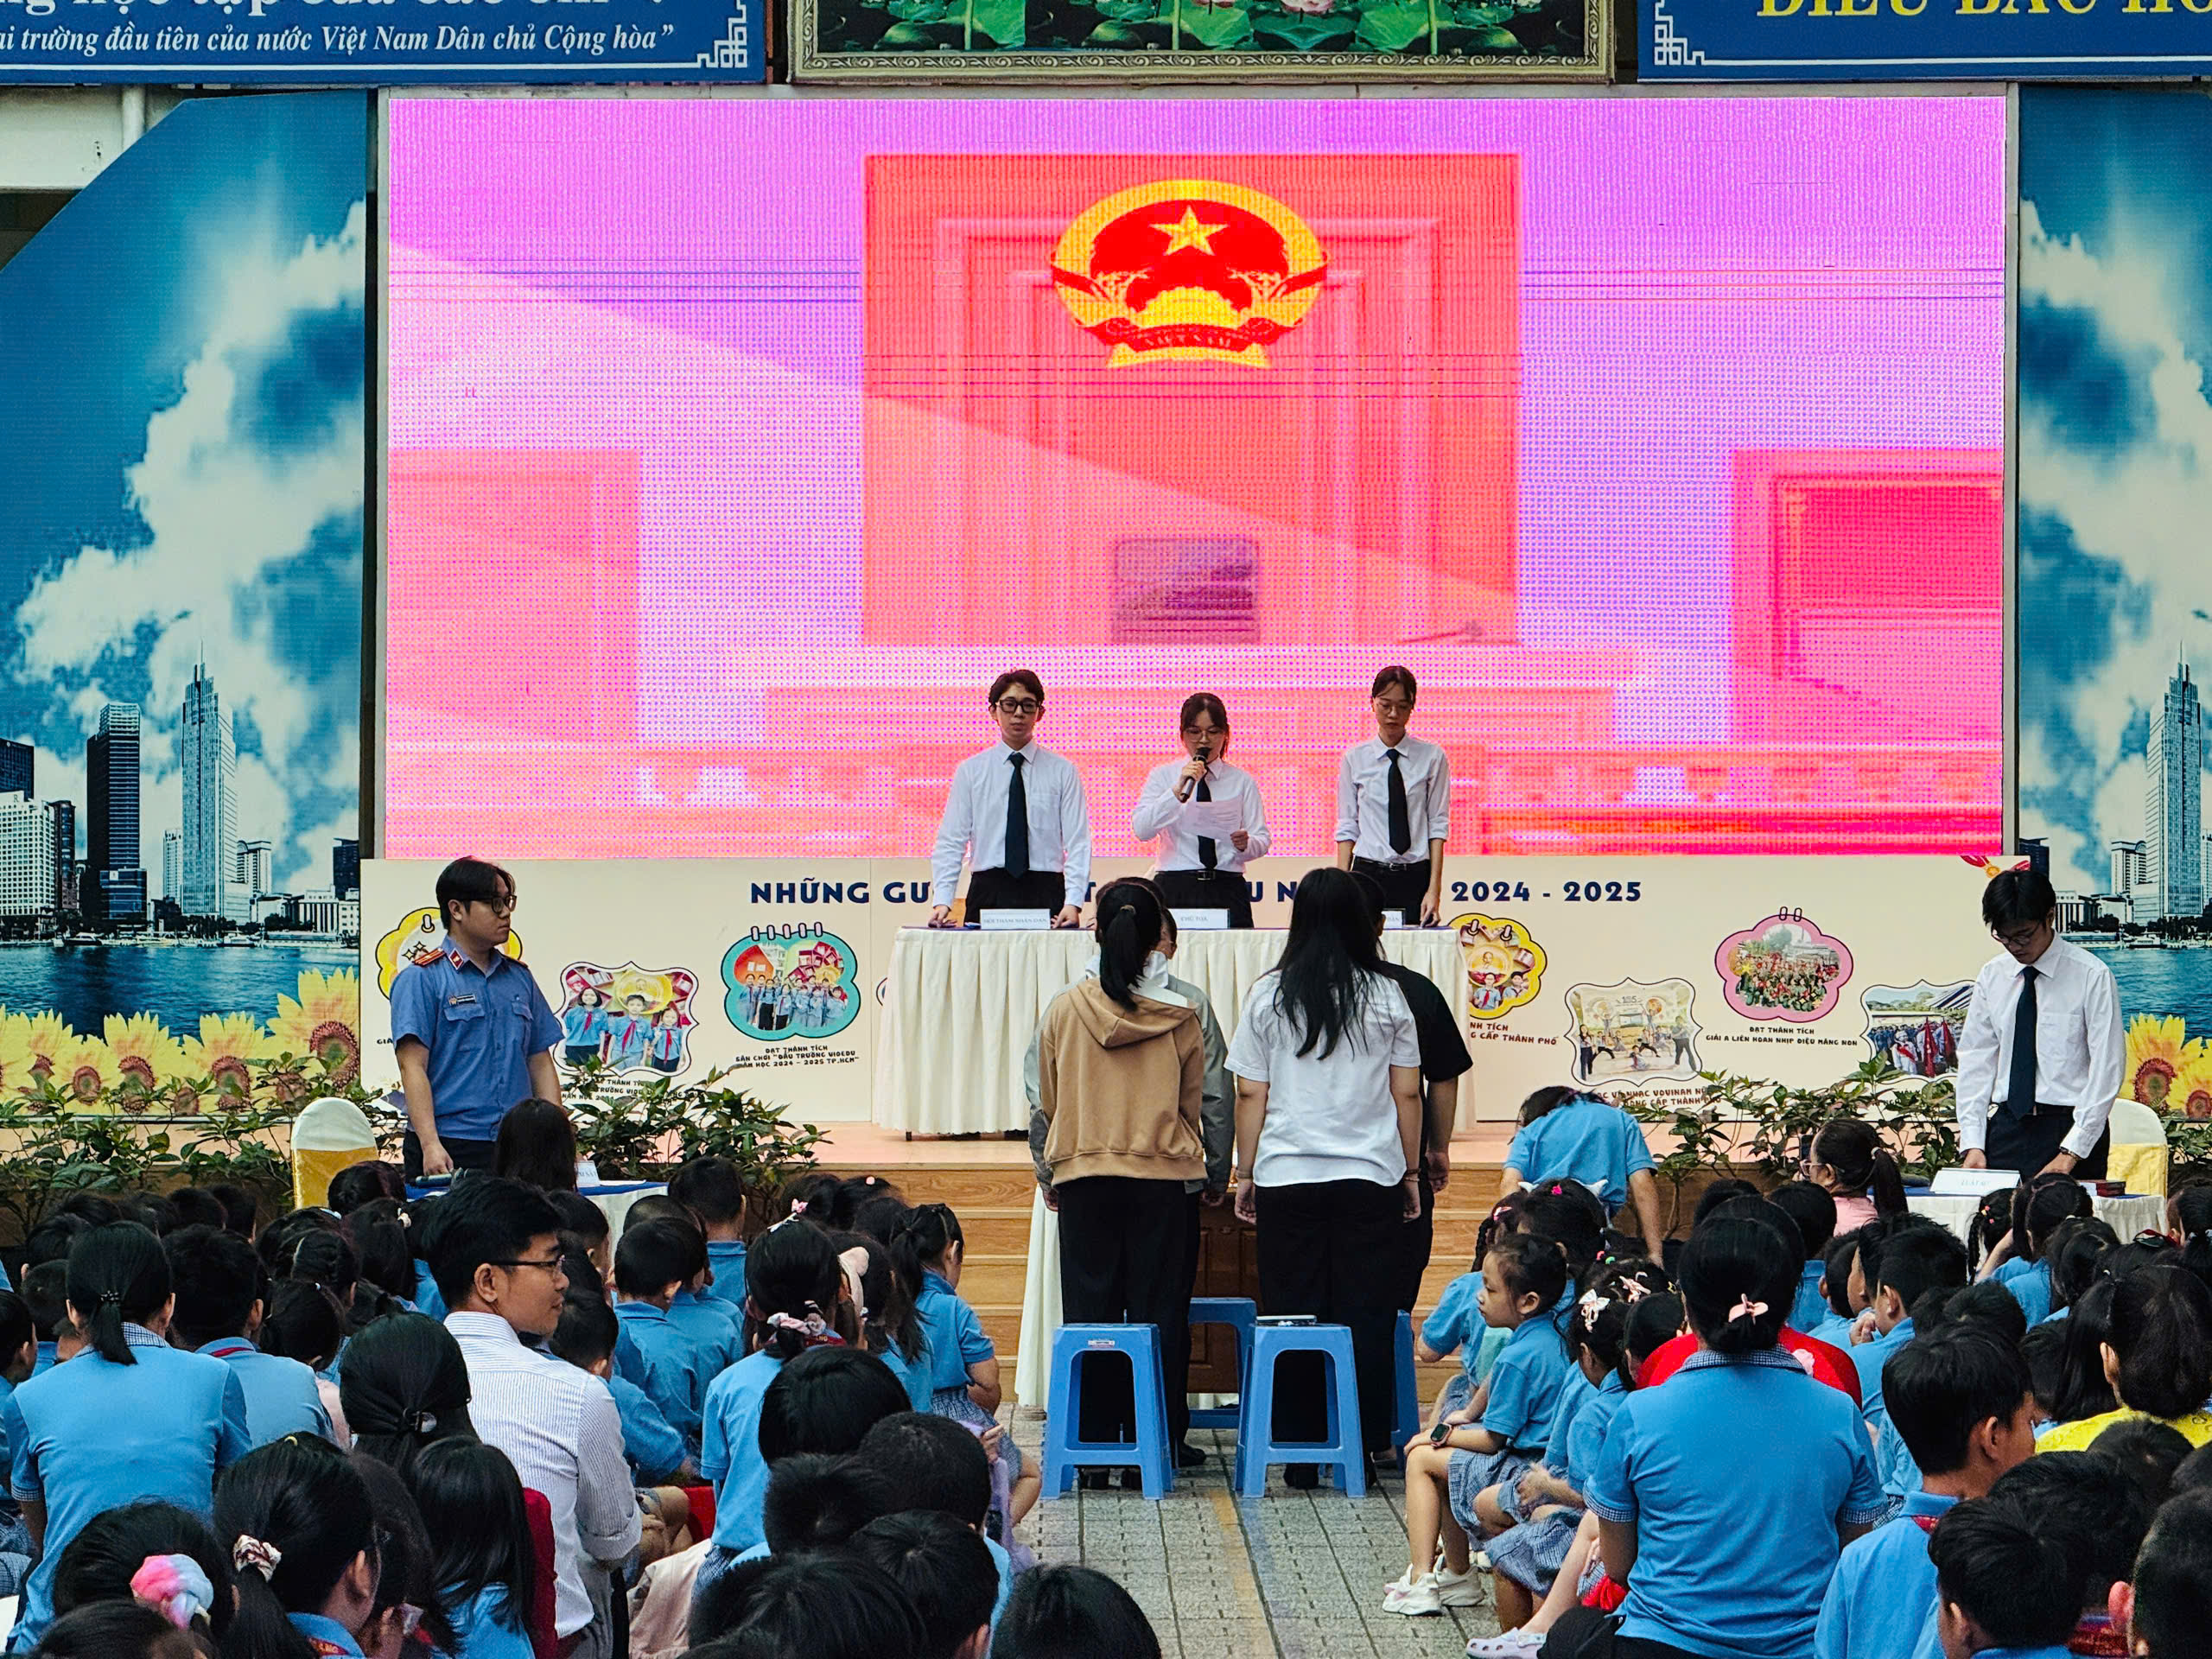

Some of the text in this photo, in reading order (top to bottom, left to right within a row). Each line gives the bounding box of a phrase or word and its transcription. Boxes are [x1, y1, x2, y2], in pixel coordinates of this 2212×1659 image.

[21, 26, 99, 57] trường
[105, 21, 149, 51] đầu
[156, 26, 200, 51] tiên
[207, 23, 249, 51] của
[257, 25, 312, 51] nước
[321, 25, 367, 55] Việt
[372, 26, 429, 51] Nam
[435, 25, 486, 51] Dân
[493, 23, 537, 50] chủ
[544, 24, 607, 56] Cộng
[751, 877, 869, 904] NHỮNG
[1451, 880, 1530, 902] 2024
[1563, 880, 1642, 902] 2025
[1486, 1022, 1509, 1031] TÍCH
[1503, 1033, 1534, 1043] THÀNH
[1653, 1088, 1692, 1096] VOVINAM
